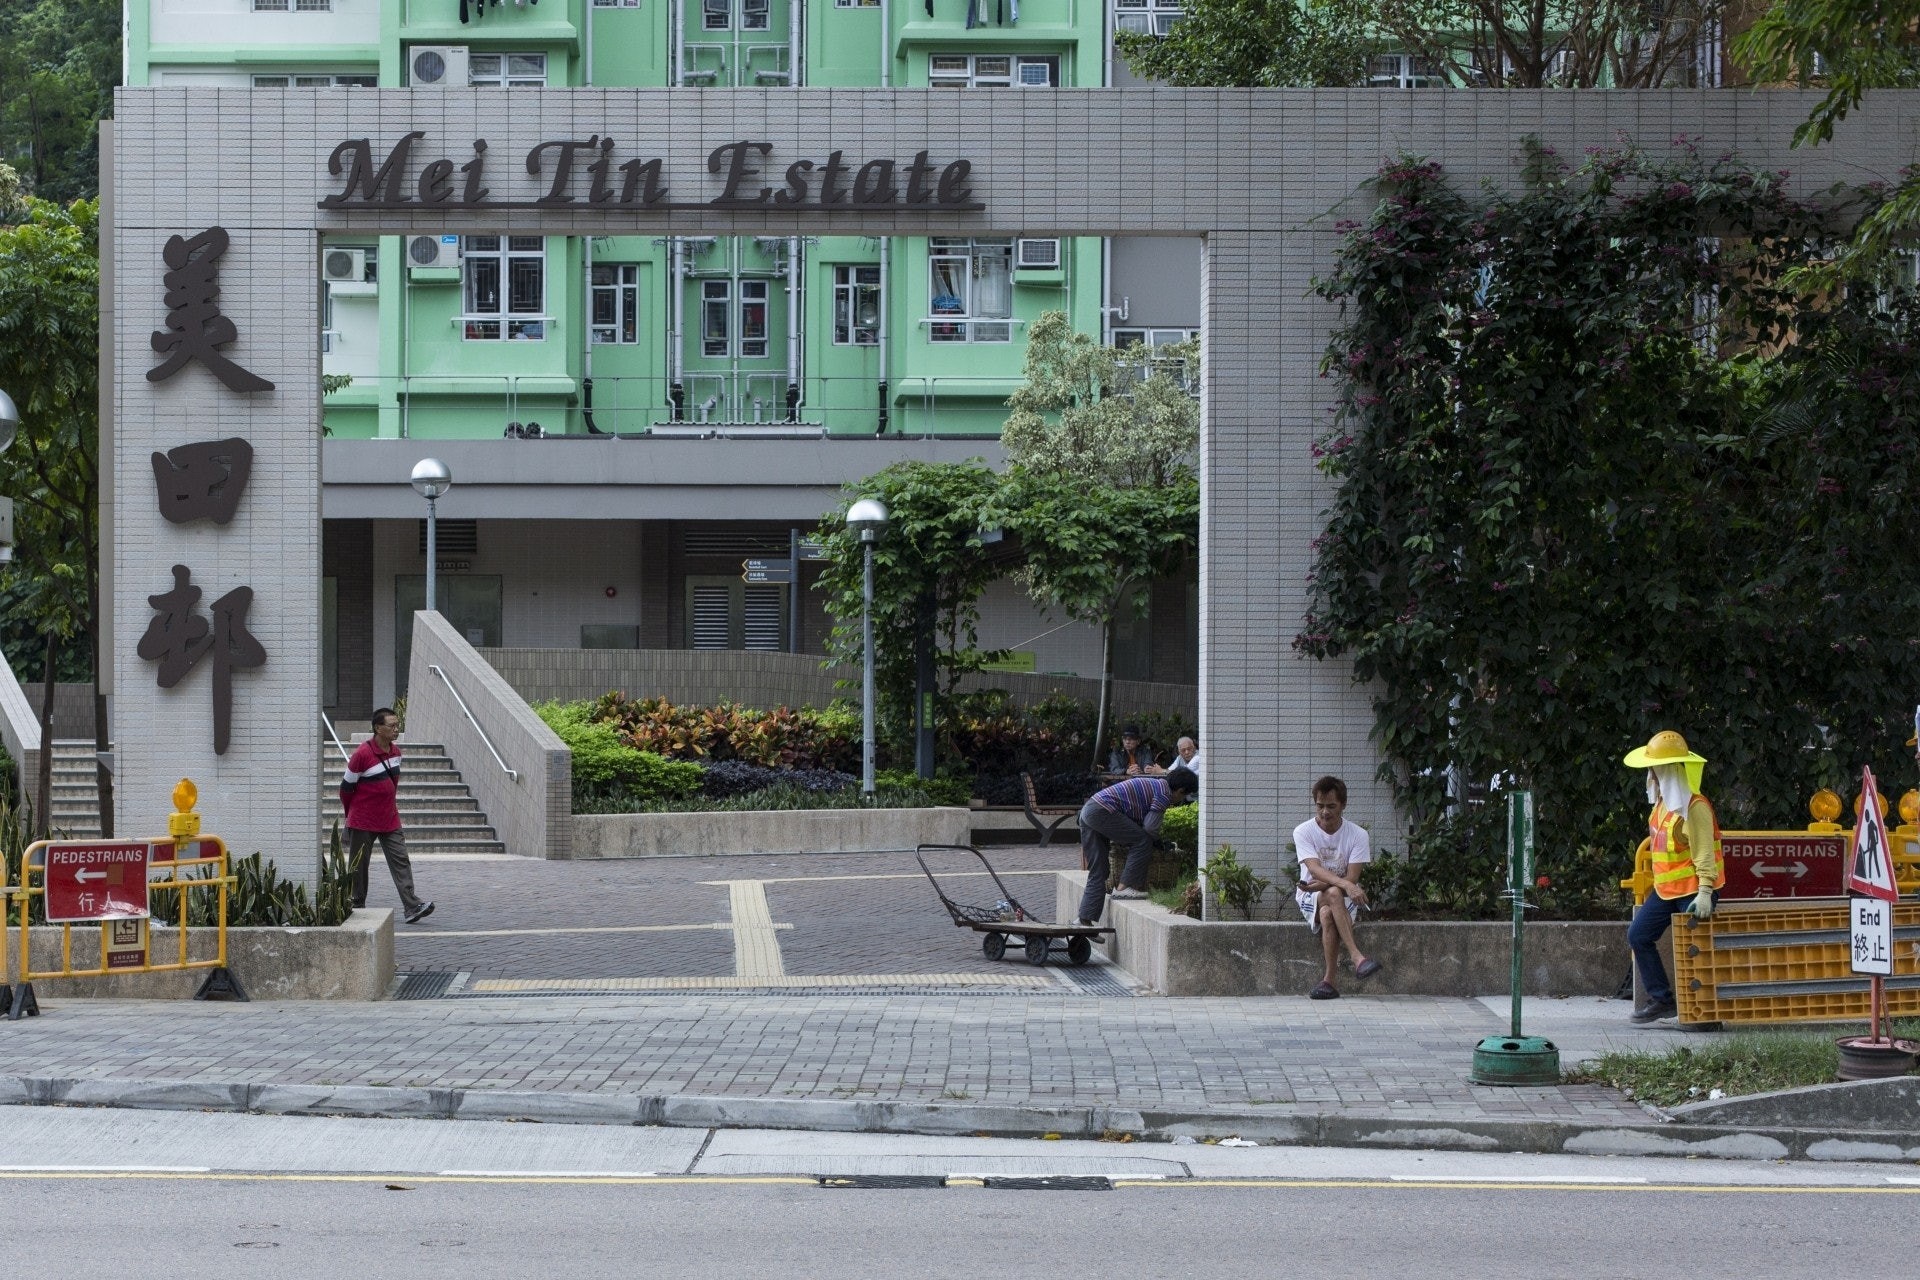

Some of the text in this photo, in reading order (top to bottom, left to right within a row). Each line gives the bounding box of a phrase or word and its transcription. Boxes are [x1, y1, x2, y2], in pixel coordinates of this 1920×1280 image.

[324, 131, 974, 204] Mei Tin Estate
[53, 849, 143, 864] PEDESTRIANS
[1722, 844, 1838, 858] PEDESTRIANS
[78, 891, 116, 912] 行人
[1860, 908, 1880, 926] End
[1853, 933, 1888, 963] 終止
